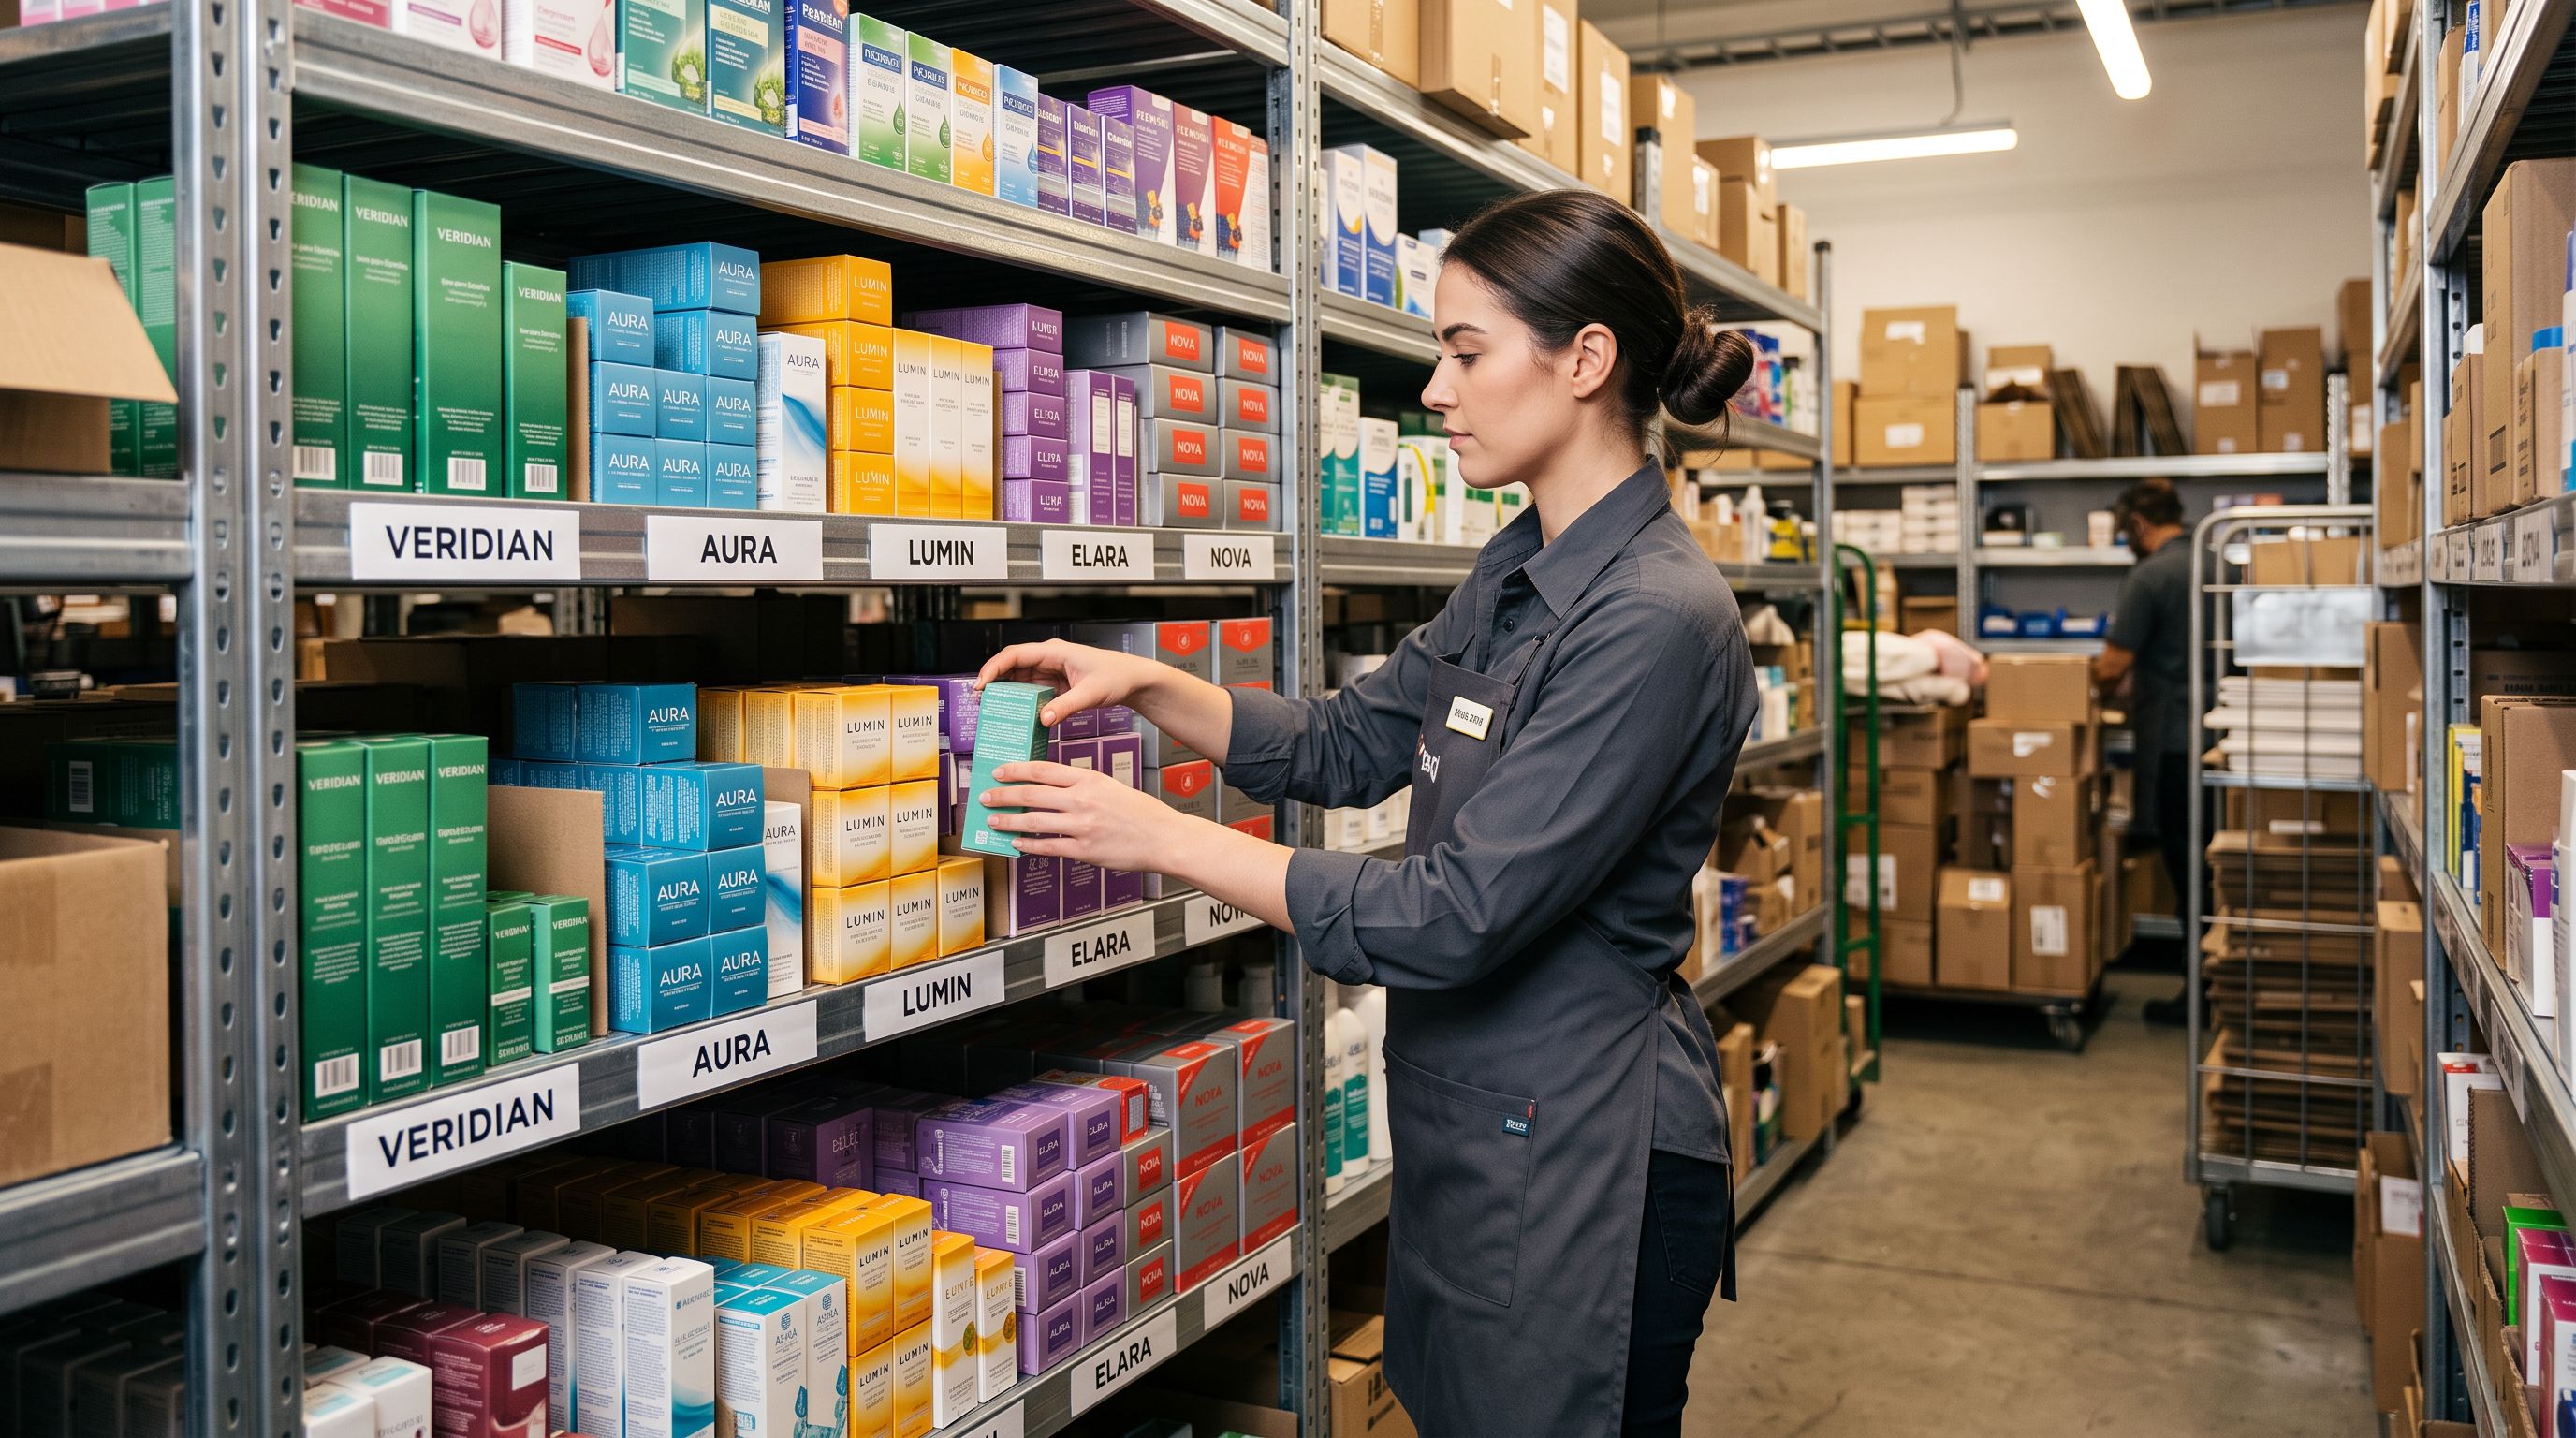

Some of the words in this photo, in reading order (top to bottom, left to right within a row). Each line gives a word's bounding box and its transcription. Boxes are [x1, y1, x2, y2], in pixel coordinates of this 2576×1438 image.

[291, 191, 338, 213] ERIDIAN
[356, 205, 408, 228] VERIDIAN
[437, 227, 492, 249] VERIDIAN
[718, 261, 754, 280] AURA
[854, 275, 887, 293] LUMIN
[518, 286, 562, 303] VERIDIAN
[607, 311, 649, 330] AURA
[715, 329, 752, 346] AURA
[1170, 334, 1195, 351] NOVA
[854, 341, 888, 358] LUMIN
[1242, 349, 1265, 364] NOVA
[787, 354, 820, 369] AURA
[898, 361, 927, 376] LUMIN
[933, 368, 959, 382] LUMIN
[964, 374, 990, 387] LUMIN
[608, 382, 650, 400] AURA
[663, 389, 700, 406] AURA
[1174, 387, 1199, 403] NOVA
[715, 396, 751, 413] AURA
[855, 405, 889, 422] LUMIN
[1242, 399, 1265, 414] NOVA
[1177, 440, 1202, 455] NOVA
[609, 453, 650, 471] AURA
[663, 458, 700, 475] AURA
[715, 462, 752, 478] AURA
[855, 470, 890, 487] LUMIN
[1181, 492, 1207, 507] NOVA
[385, 524, 554, 562] VERIDIAN
[699, 533, 778, 565] AURA
[908, 538, 974, 566] LUMIN
[1072, 543, 1129, 568] ELARA
[1210, 547, 1252, 569] NOVA
[647, 706, 690, 725] AURA
[897, 714, 933, 729] LUMIN
[846, 719, 886, 734] LUMIN
[375, 769, 425, 785] VERIDIAN
[437, 763, 485, 779] VERIDIAN
[308, 774, 361, 792] VERIDIAN
[715, 788, 757, 808] AURA
[845, 814, 886, 832] LUMIN
[896, 807, 933, 824] LUMIN
[764, 824, 796, 841] AURA
[717, 869, 759, 890] AURA
[656, 879, 700, 902] AURA
[945, 886, 980, 905] LUMIN
[896, 898, 932, 917] LUMIN
[1209, 902, 1244, 928] NOV
[846, 908, 886, 929] LUMIN
[1071, 930, 1132, 968] ELARA
[720, 950, 762, 973] AURA
[659, 962, 703, 988] AURA
[902, 972, 973, 1018] LUMIN
[692, 1029, 771, 1078] AURA
[378, 1088, 554, 1168] VERIDIAN
[899, 1227, 929, 1249] LUMIN
[859, 1244, 890, 1268] LUMIN
[1227, 1262, 1270, 1305] NOVA
[899, 1342, 929, 1365] LUMIN
[1095, 1336, 1153, 1392] ELARA
[859, 1363, 890, 1387] LUMIN
